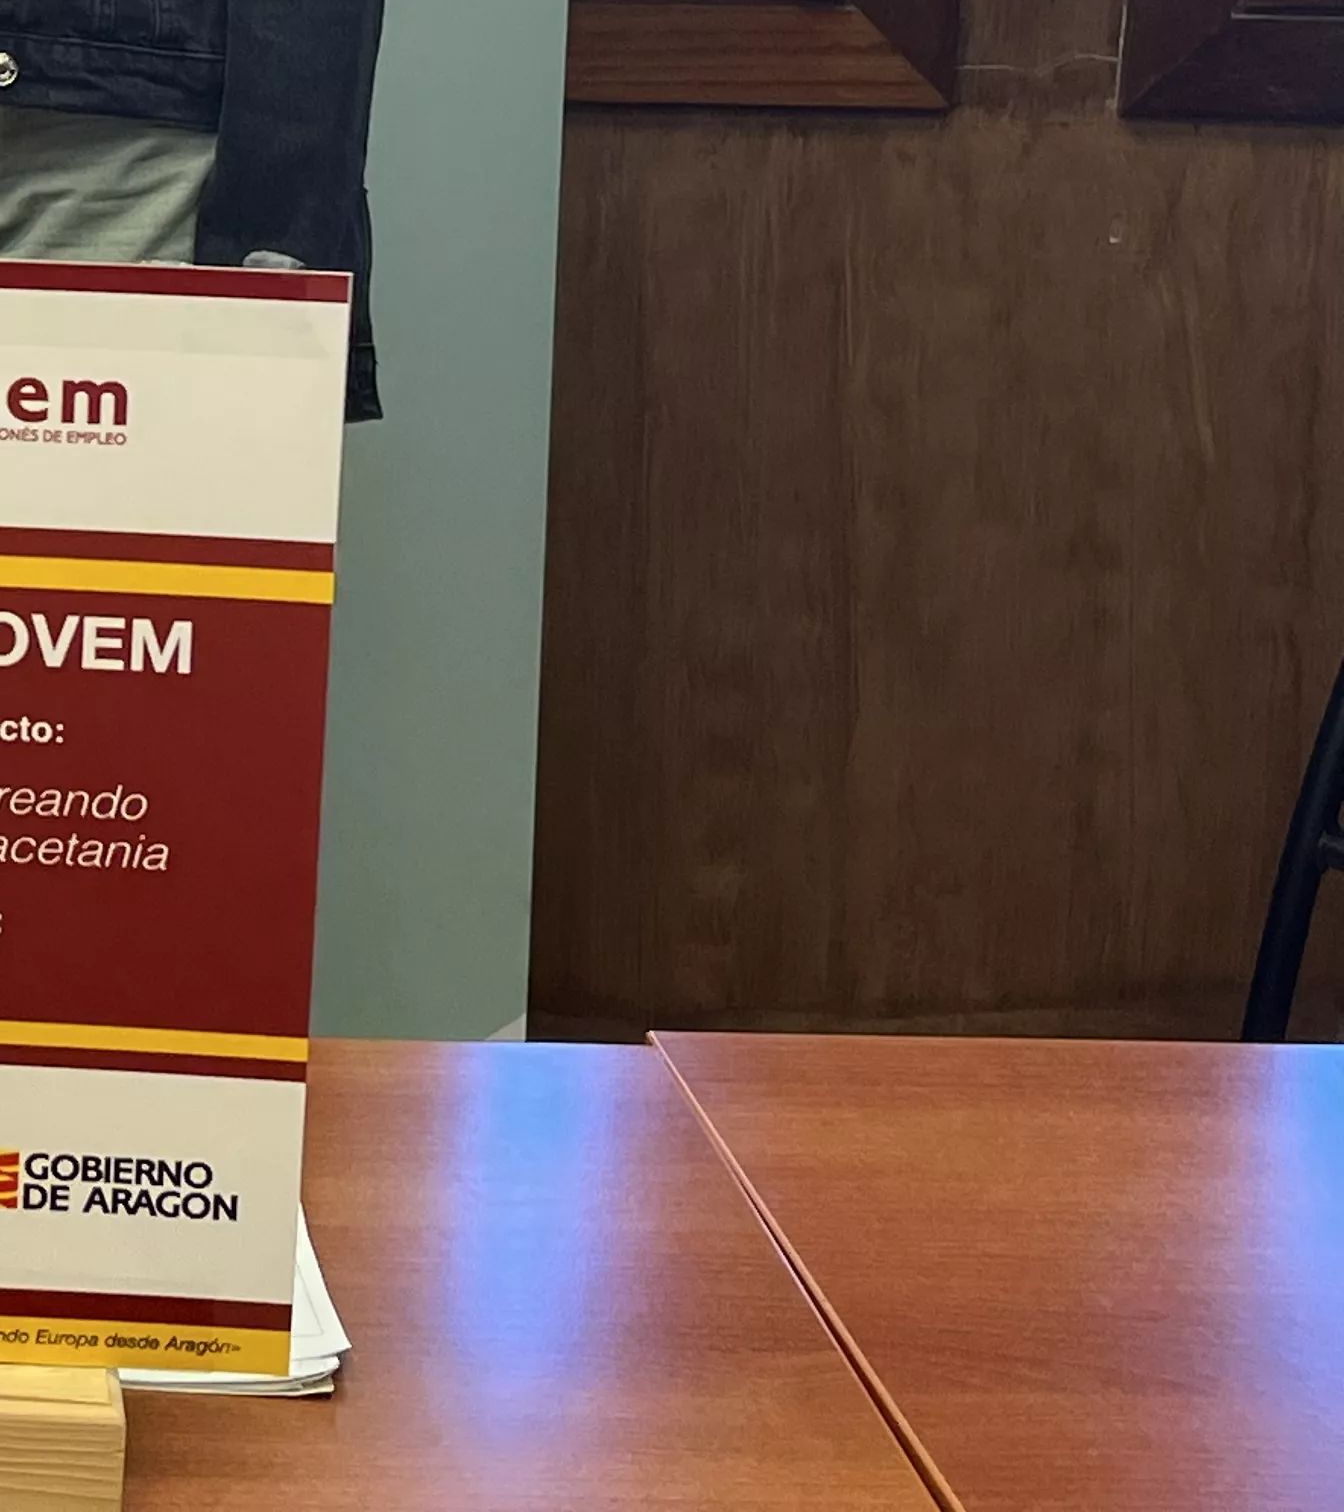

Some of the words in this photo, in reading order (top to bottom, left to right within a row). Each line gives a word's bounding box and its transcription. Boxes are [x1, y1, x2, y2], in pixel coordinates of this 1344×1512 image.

[42, 429, 63, 444] DE
[65, 430, 128, 446] EMPLEO
[23, 1152, 213, 1190] GOBIERNO
[22, 1183, 70, 1212] DE
[82, 1186, 239, 1222] ARAGON
[35, 1328, 100, 1351] Europa
[104, 1332, 161, 1351] desde
